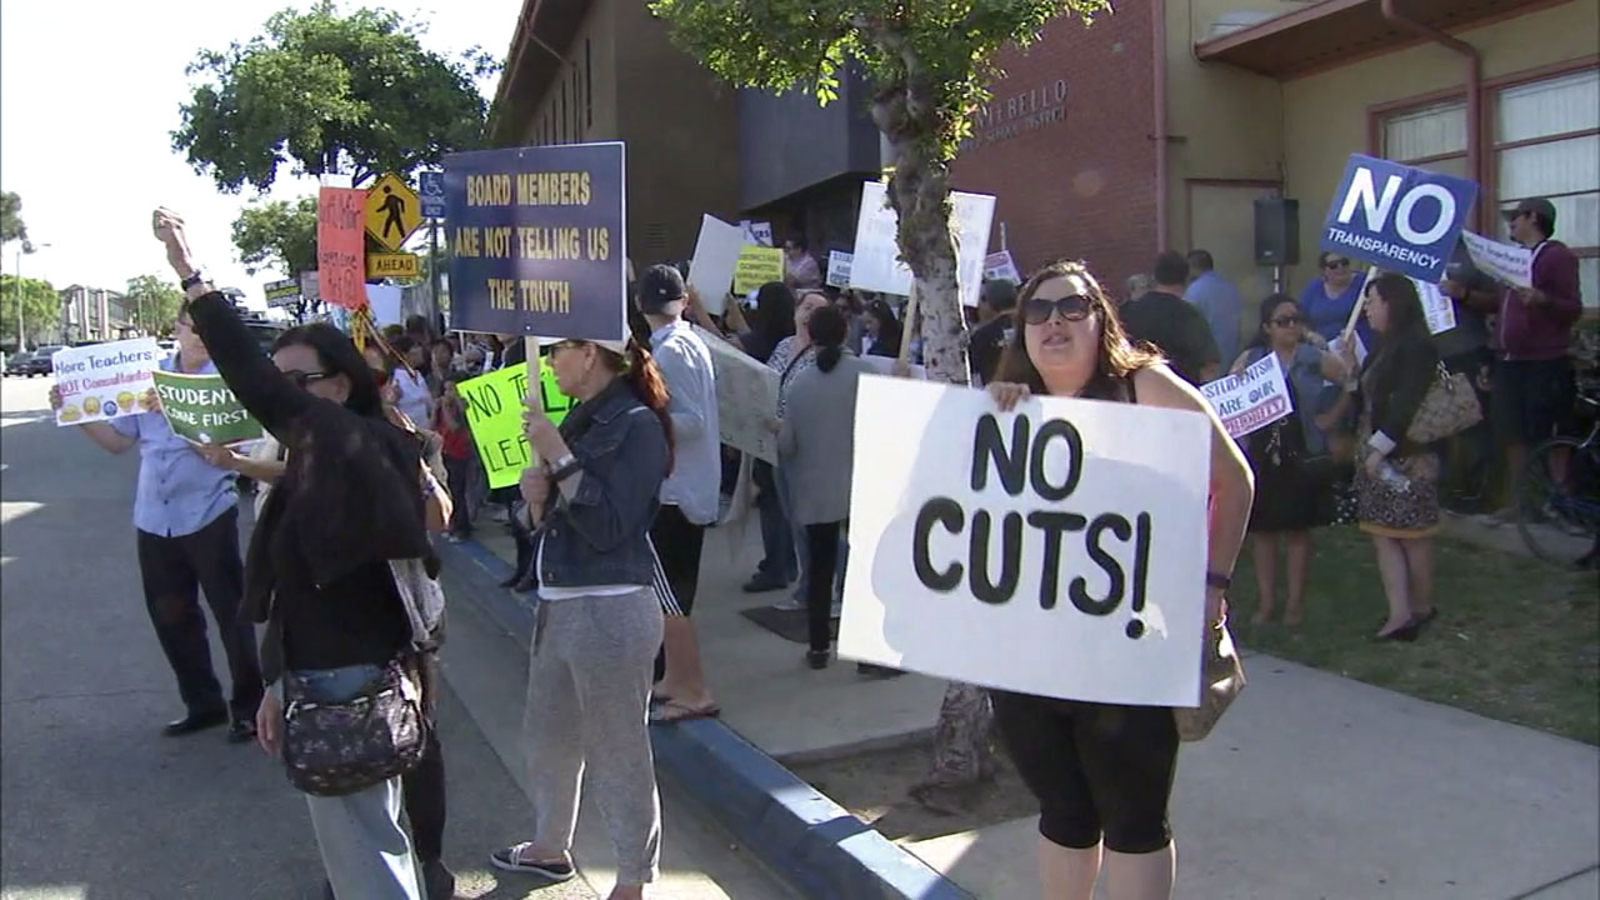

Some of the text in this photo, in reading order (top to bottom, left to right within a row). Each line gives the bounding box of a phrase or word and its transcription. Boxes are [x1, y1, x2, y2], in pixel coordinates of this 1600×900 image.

[467, 171, 591, 207] BOARD MEMBERS
[1337, 166, 1456, 246] NO
[454, 226, 609, 261] ARE NOT TELLING US
[1328, 227, 1441, 270] TRANSPARENCY
[376, 258, 414, 272] AHEAD
[488, 278, 570, 314] THE TRUTH
[55, 350, 153, 376] More Teachers
[58, 379, 79, 395] NOT
[158, 383, 237, 407] STUDENT
[467, 383, 502, 423] NO
[1218, 379, 1276, 418] ARE OUR
[165, 404, 250, 428] COME FIRST
[970, 412, 1084, 502] NO
[911, 495, 1152, 640] CUTS!
